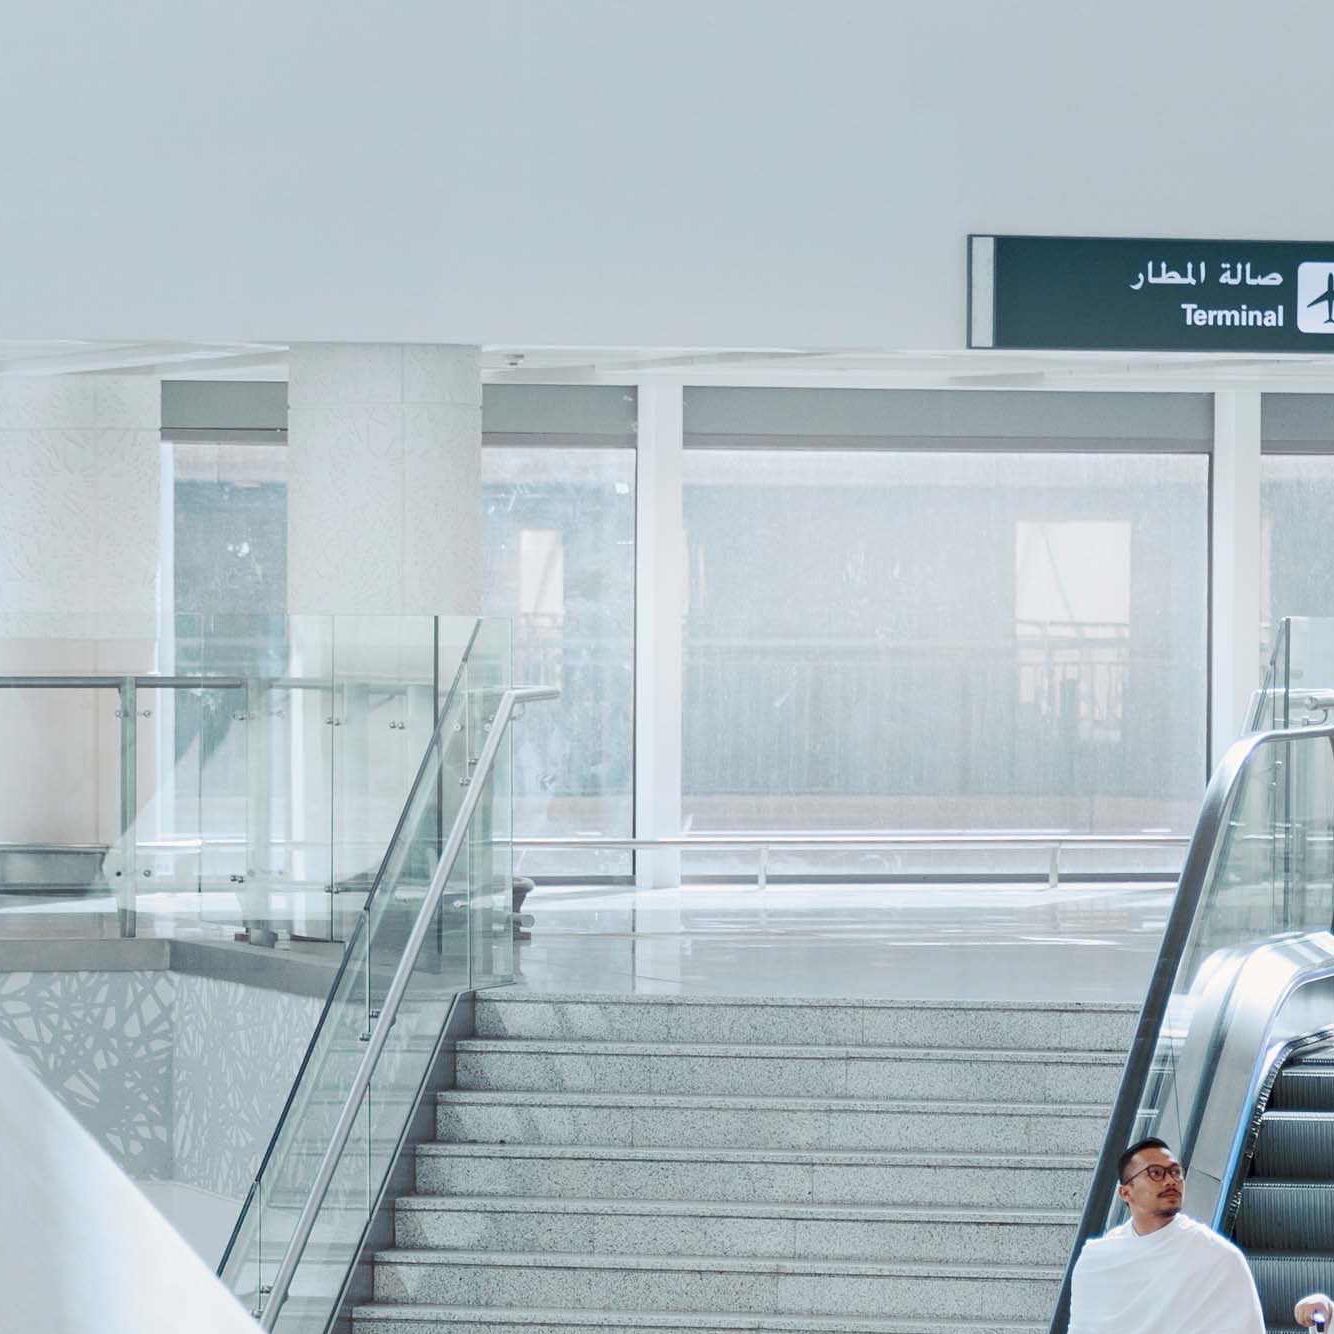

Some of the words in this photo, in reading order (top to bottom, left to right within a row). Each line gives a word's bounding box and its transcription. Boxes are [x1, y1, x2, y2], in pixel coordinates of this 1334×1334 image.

[1131, 262, 1205, 289] المطار
[1219, 263, 1283, 285] صالة
[1181, 304, 1283, 326] Terminal
